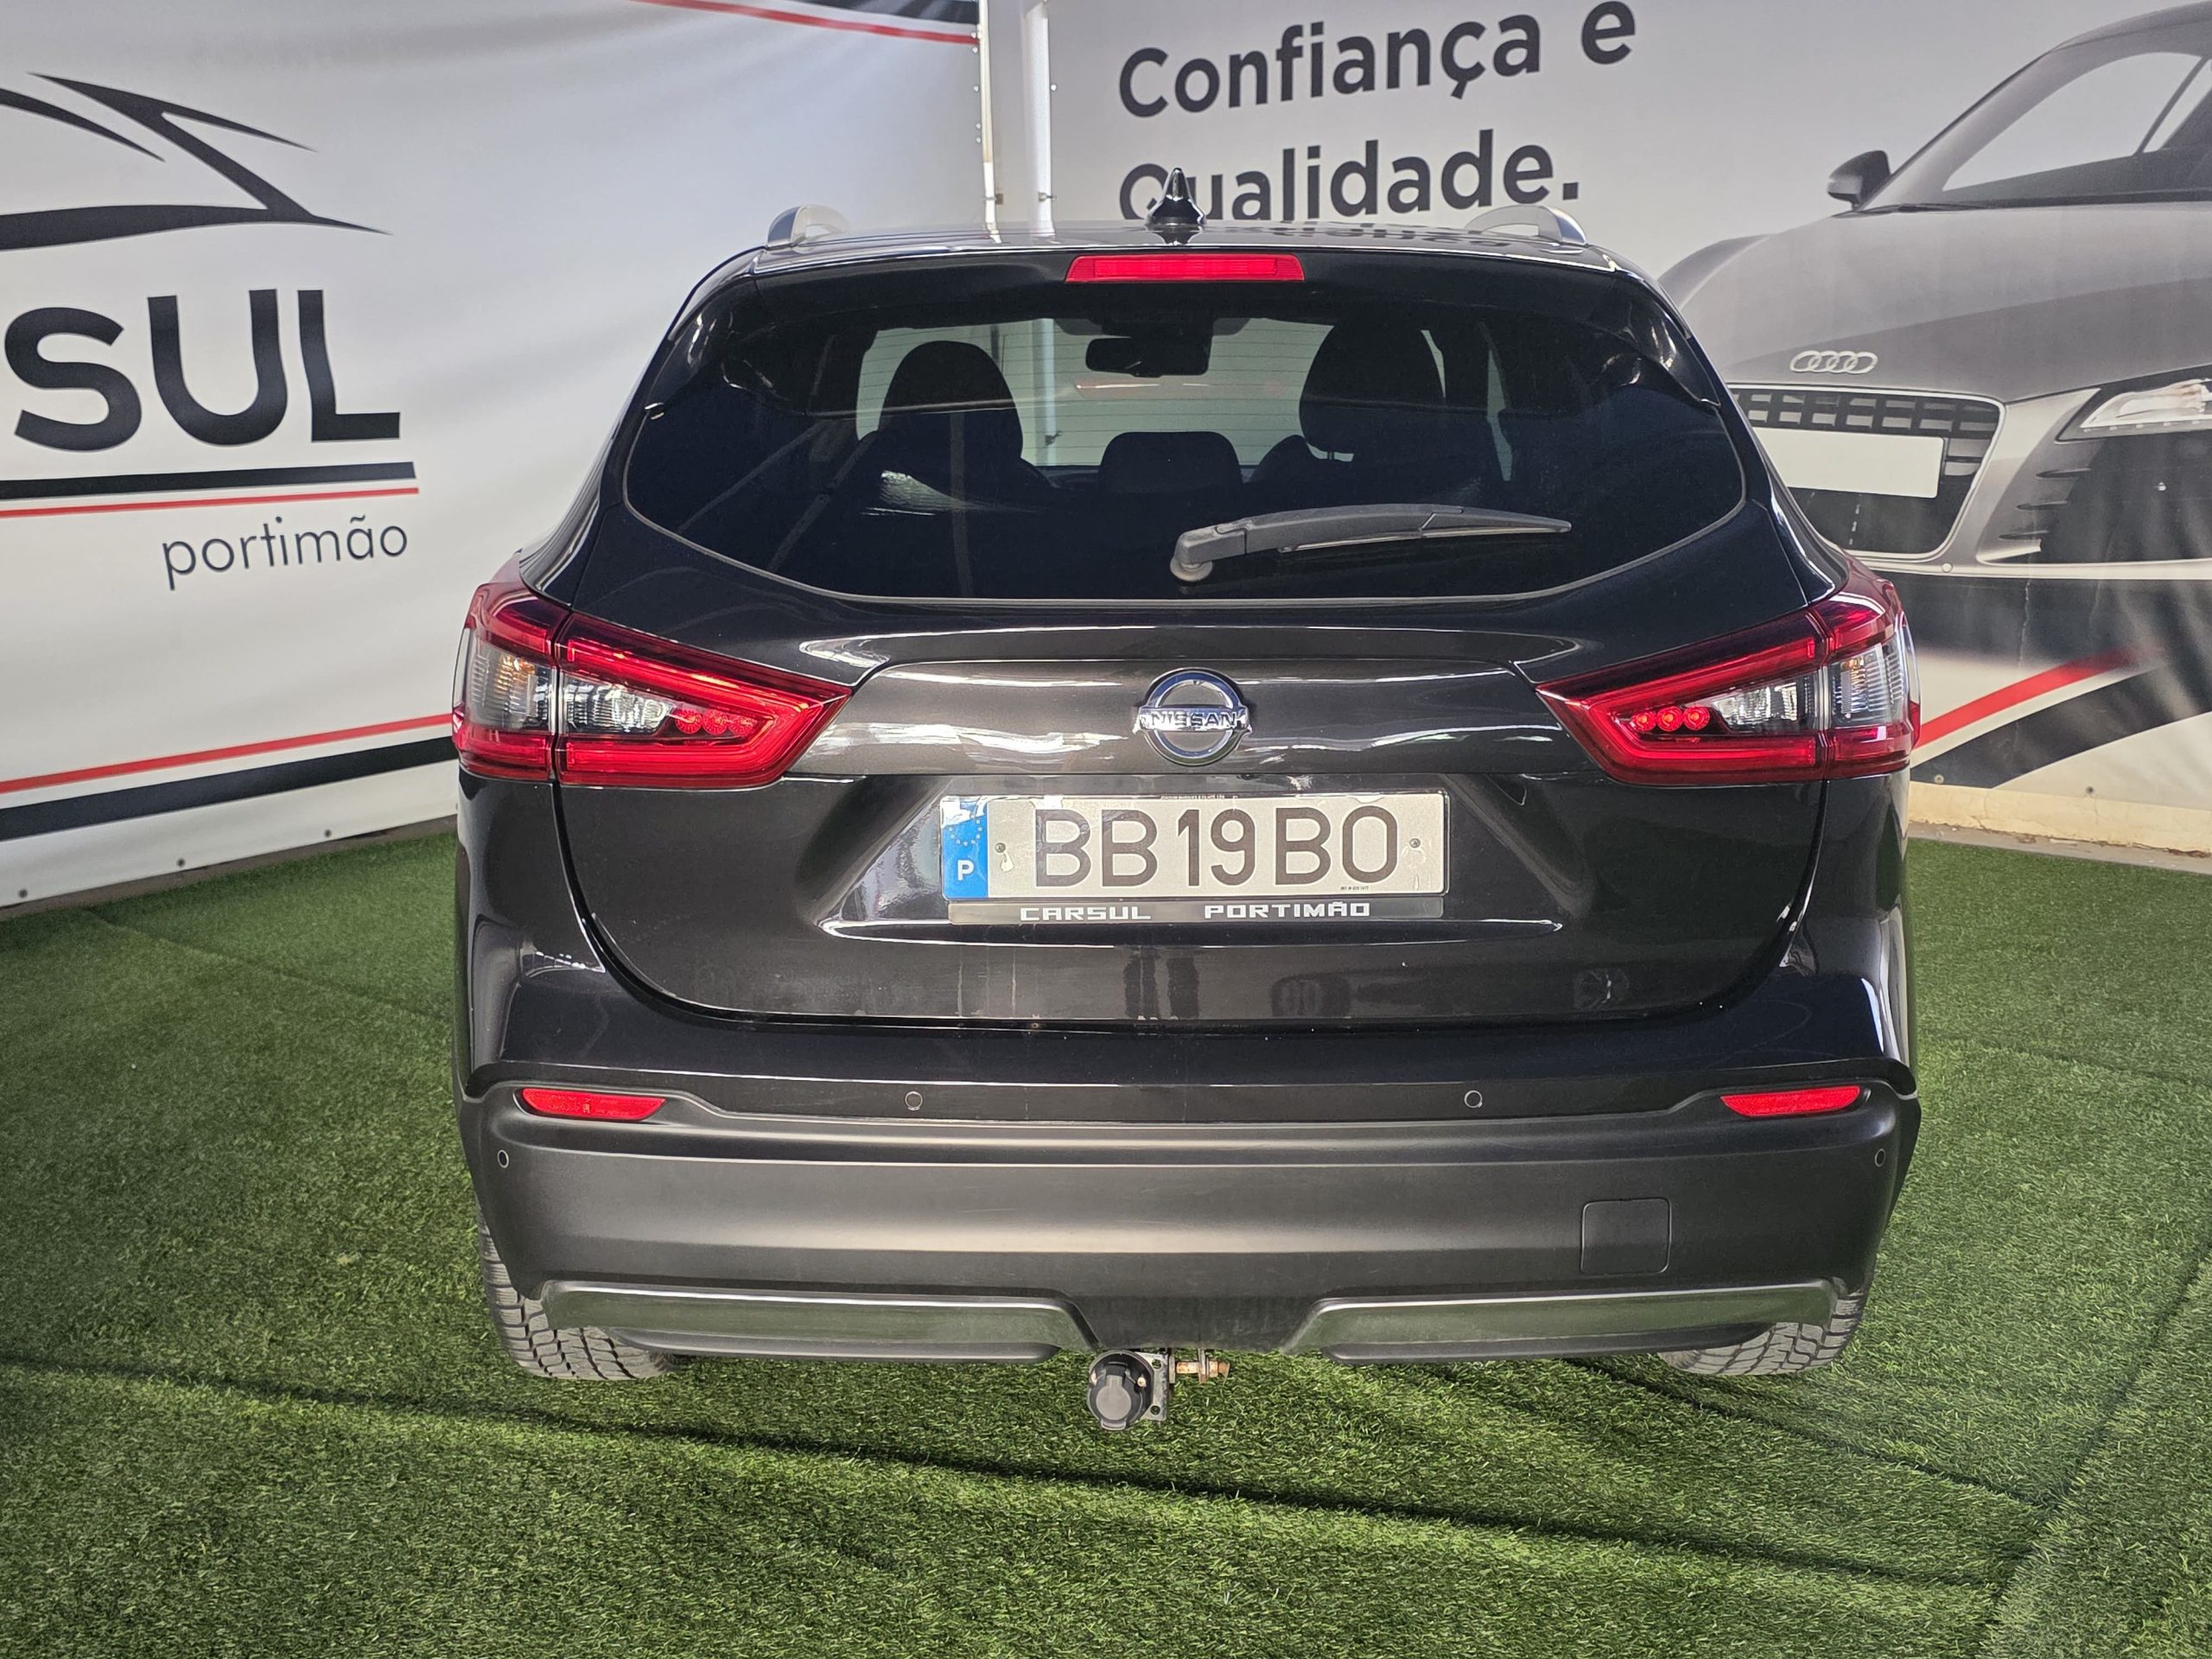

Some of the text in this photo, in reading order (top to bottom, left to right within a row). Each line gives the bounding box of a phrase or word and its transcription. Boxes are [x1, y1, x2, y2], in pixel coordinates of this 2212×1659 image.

[1119, 0, 1635, 118] Confiança e
[3, 288, 401, 453] SUL
[162, 514, 409, 591] portimão
[1149, 710, 1237, 729] NISSAN
[956, 860, 975, 881] P
[1020, 901, 1371, 921] CARSUL PORTIMÃO
